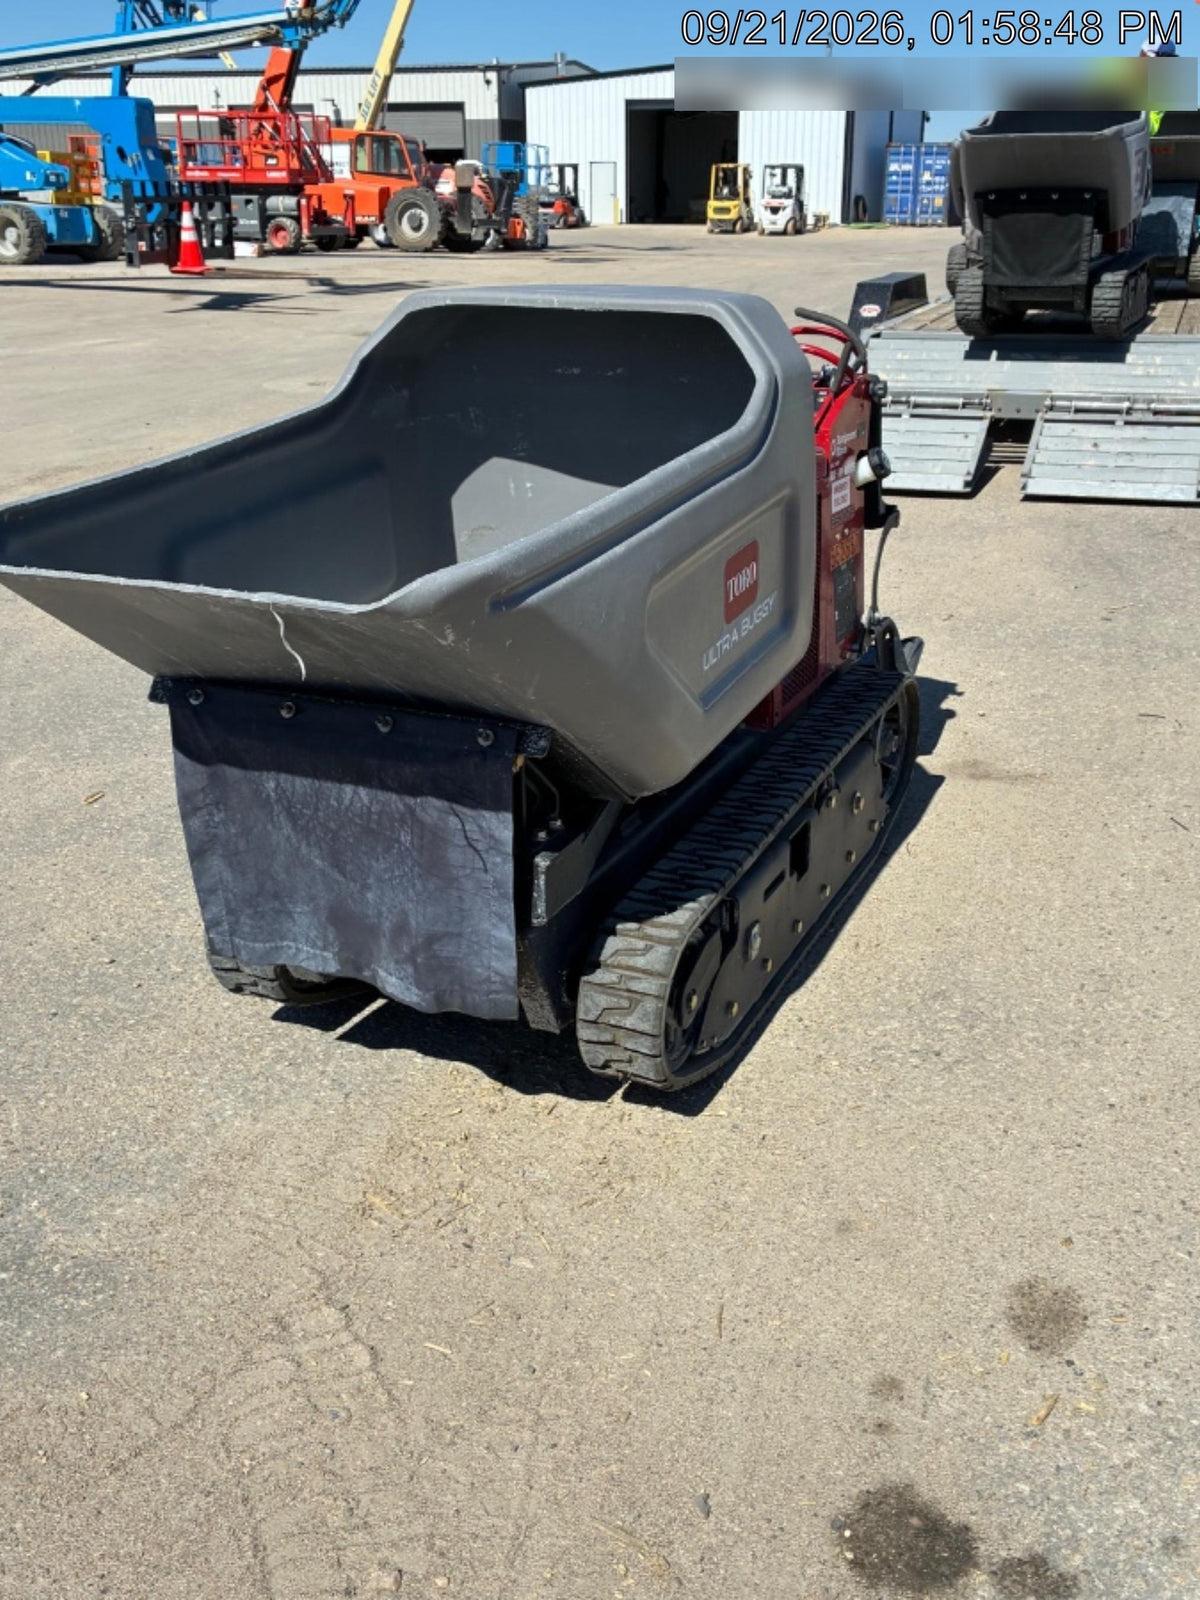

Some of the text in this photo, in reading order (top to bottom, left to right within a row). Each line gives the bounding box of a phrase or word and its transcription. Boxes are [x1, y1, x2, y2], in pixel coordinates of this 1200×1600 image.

[727, 561, 757, 603] TORO
[702, 590, 778, 670] ULTRA BUGGY
